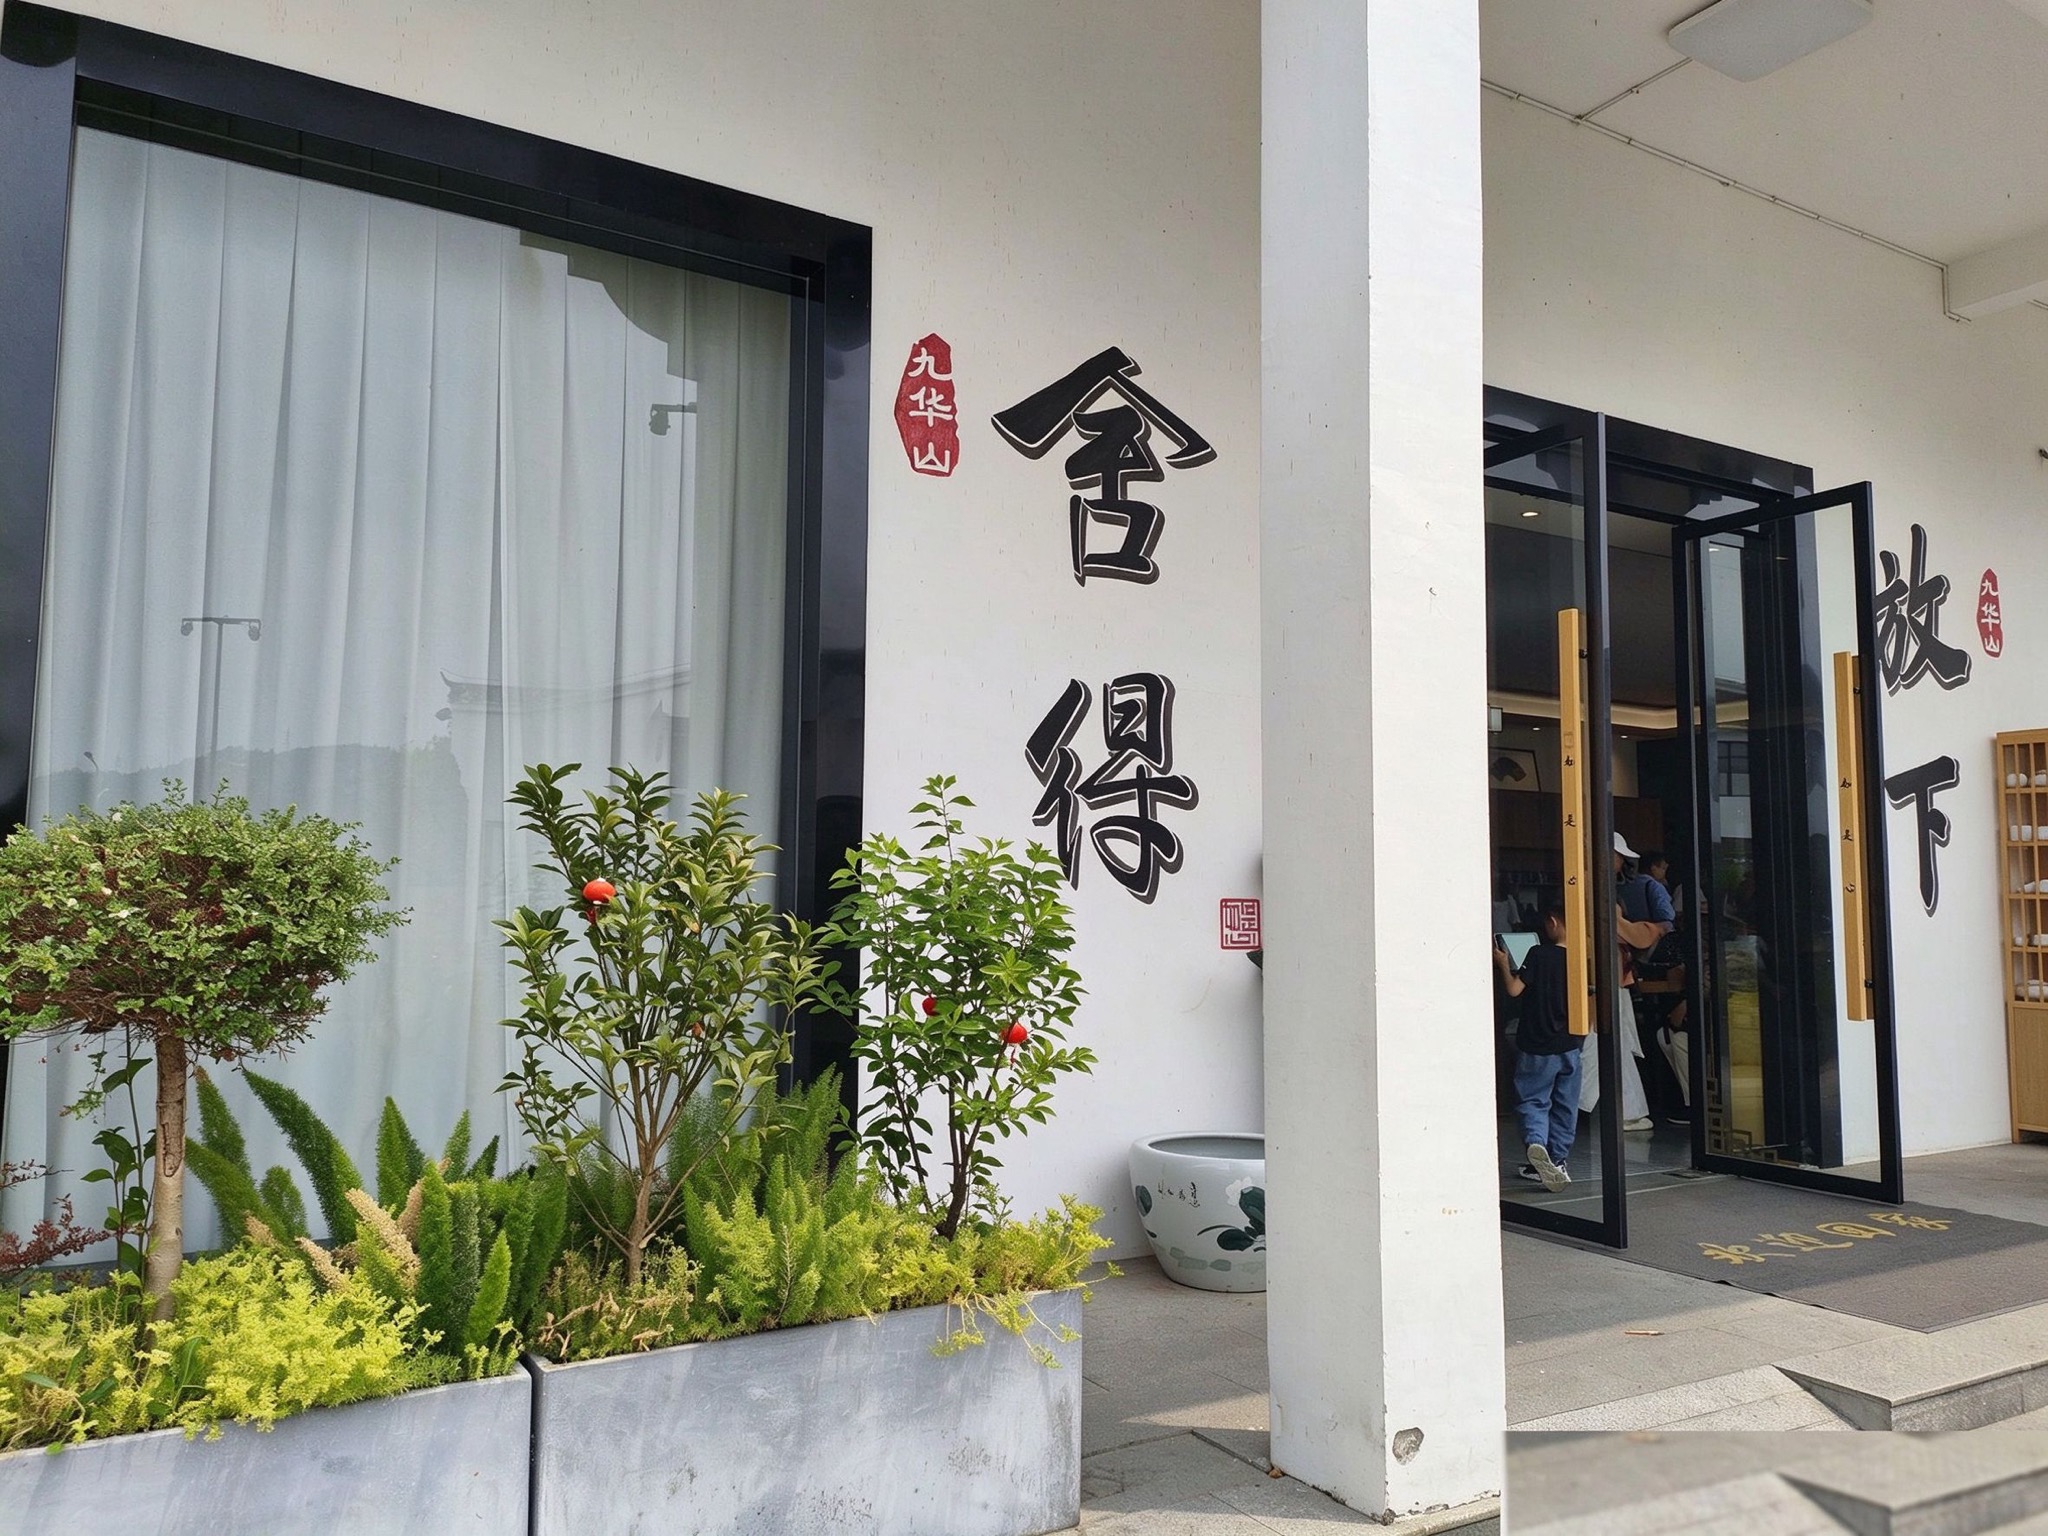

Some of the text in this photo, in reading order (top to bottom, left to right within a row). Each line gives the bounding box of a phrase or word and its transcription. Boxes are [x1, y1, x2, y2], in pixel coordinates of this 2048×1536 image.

[908, 346, 953, 474] 九华山
[990, 345, 1219, 905] 舍得
[1874, 522, 1973, 918] 放下
[1980, 578, 2000, 654] 九华山
